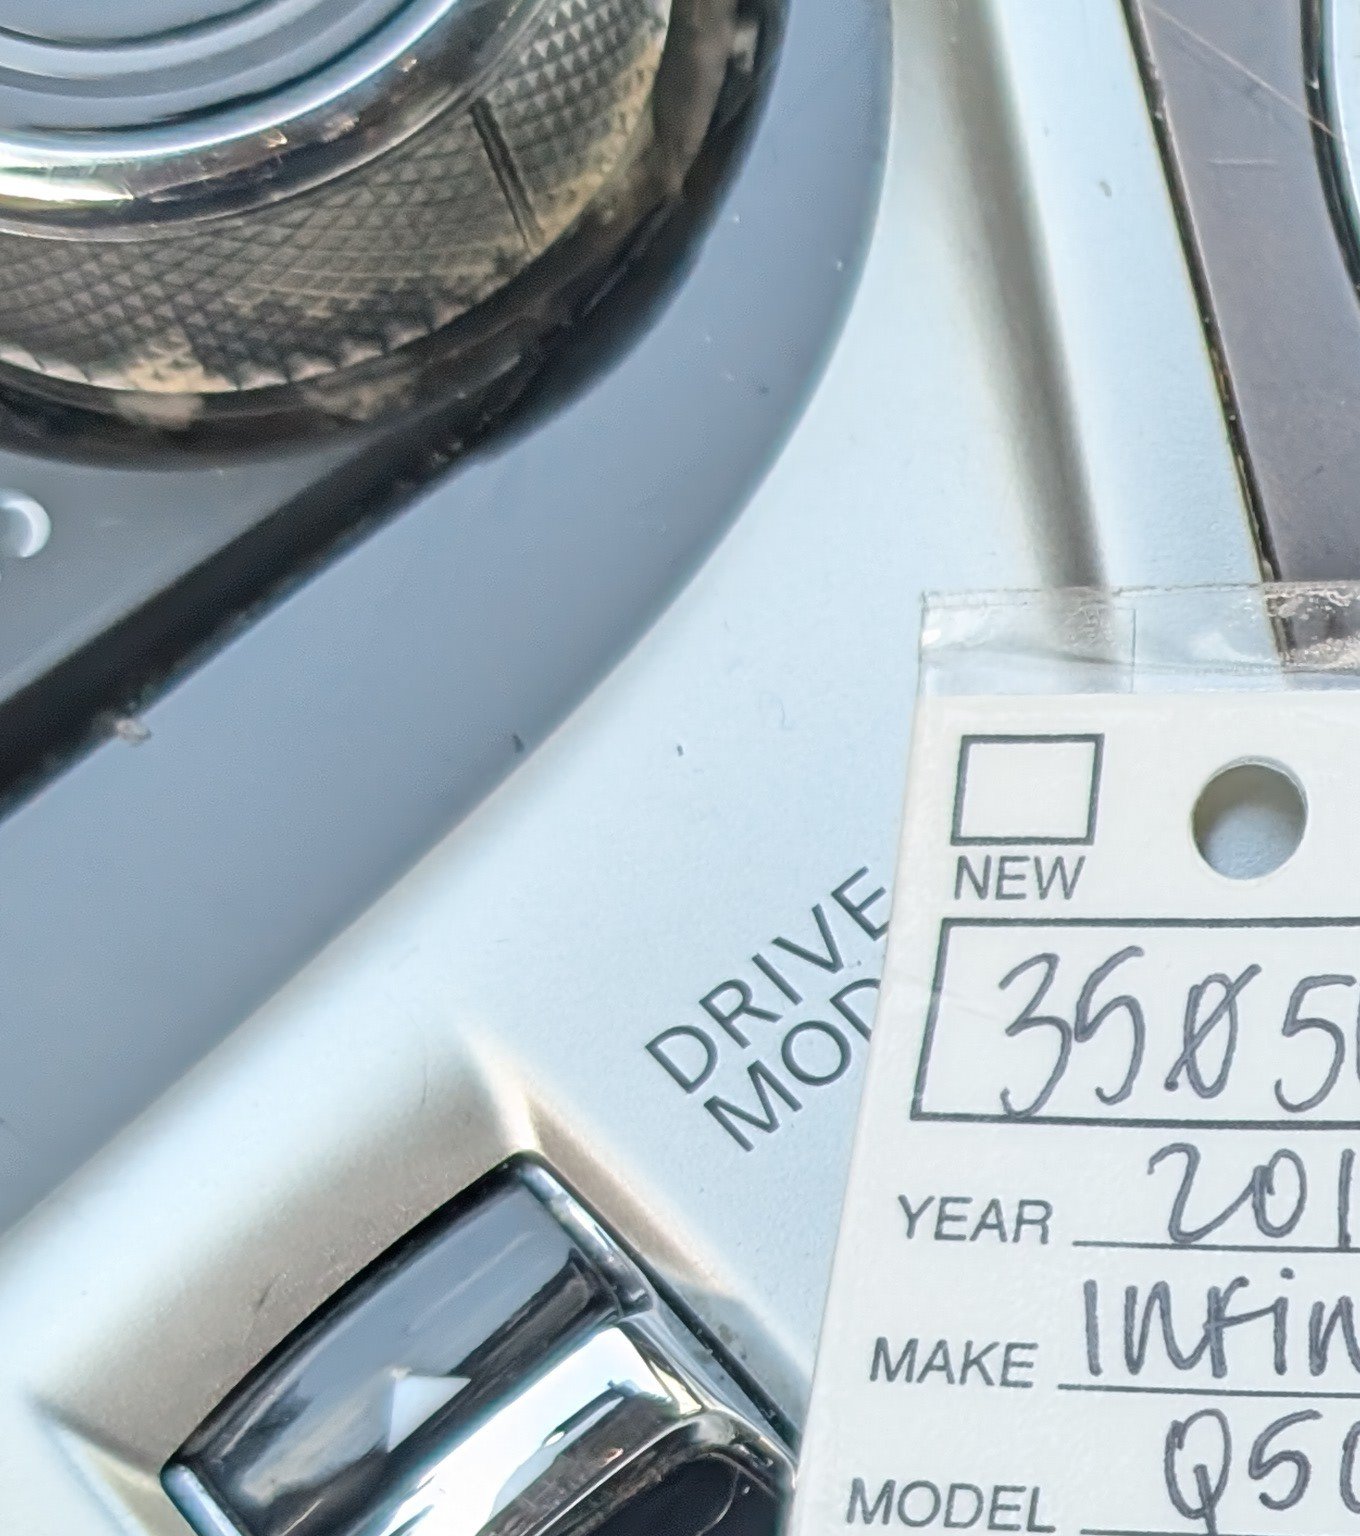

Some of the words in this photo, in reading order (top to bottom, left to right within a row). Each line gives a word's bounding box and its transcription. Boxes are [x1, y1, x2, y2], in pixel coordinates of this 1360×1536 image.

[953, 855, 1086, 901] NEW
[644, 865, 890, 1094] DRIVE
[897, 1195, 1053, 1245] YEAR
[868, 1336, 1039, 1389] MAKE
[845, 1477, 1056, 1535] MODEL
